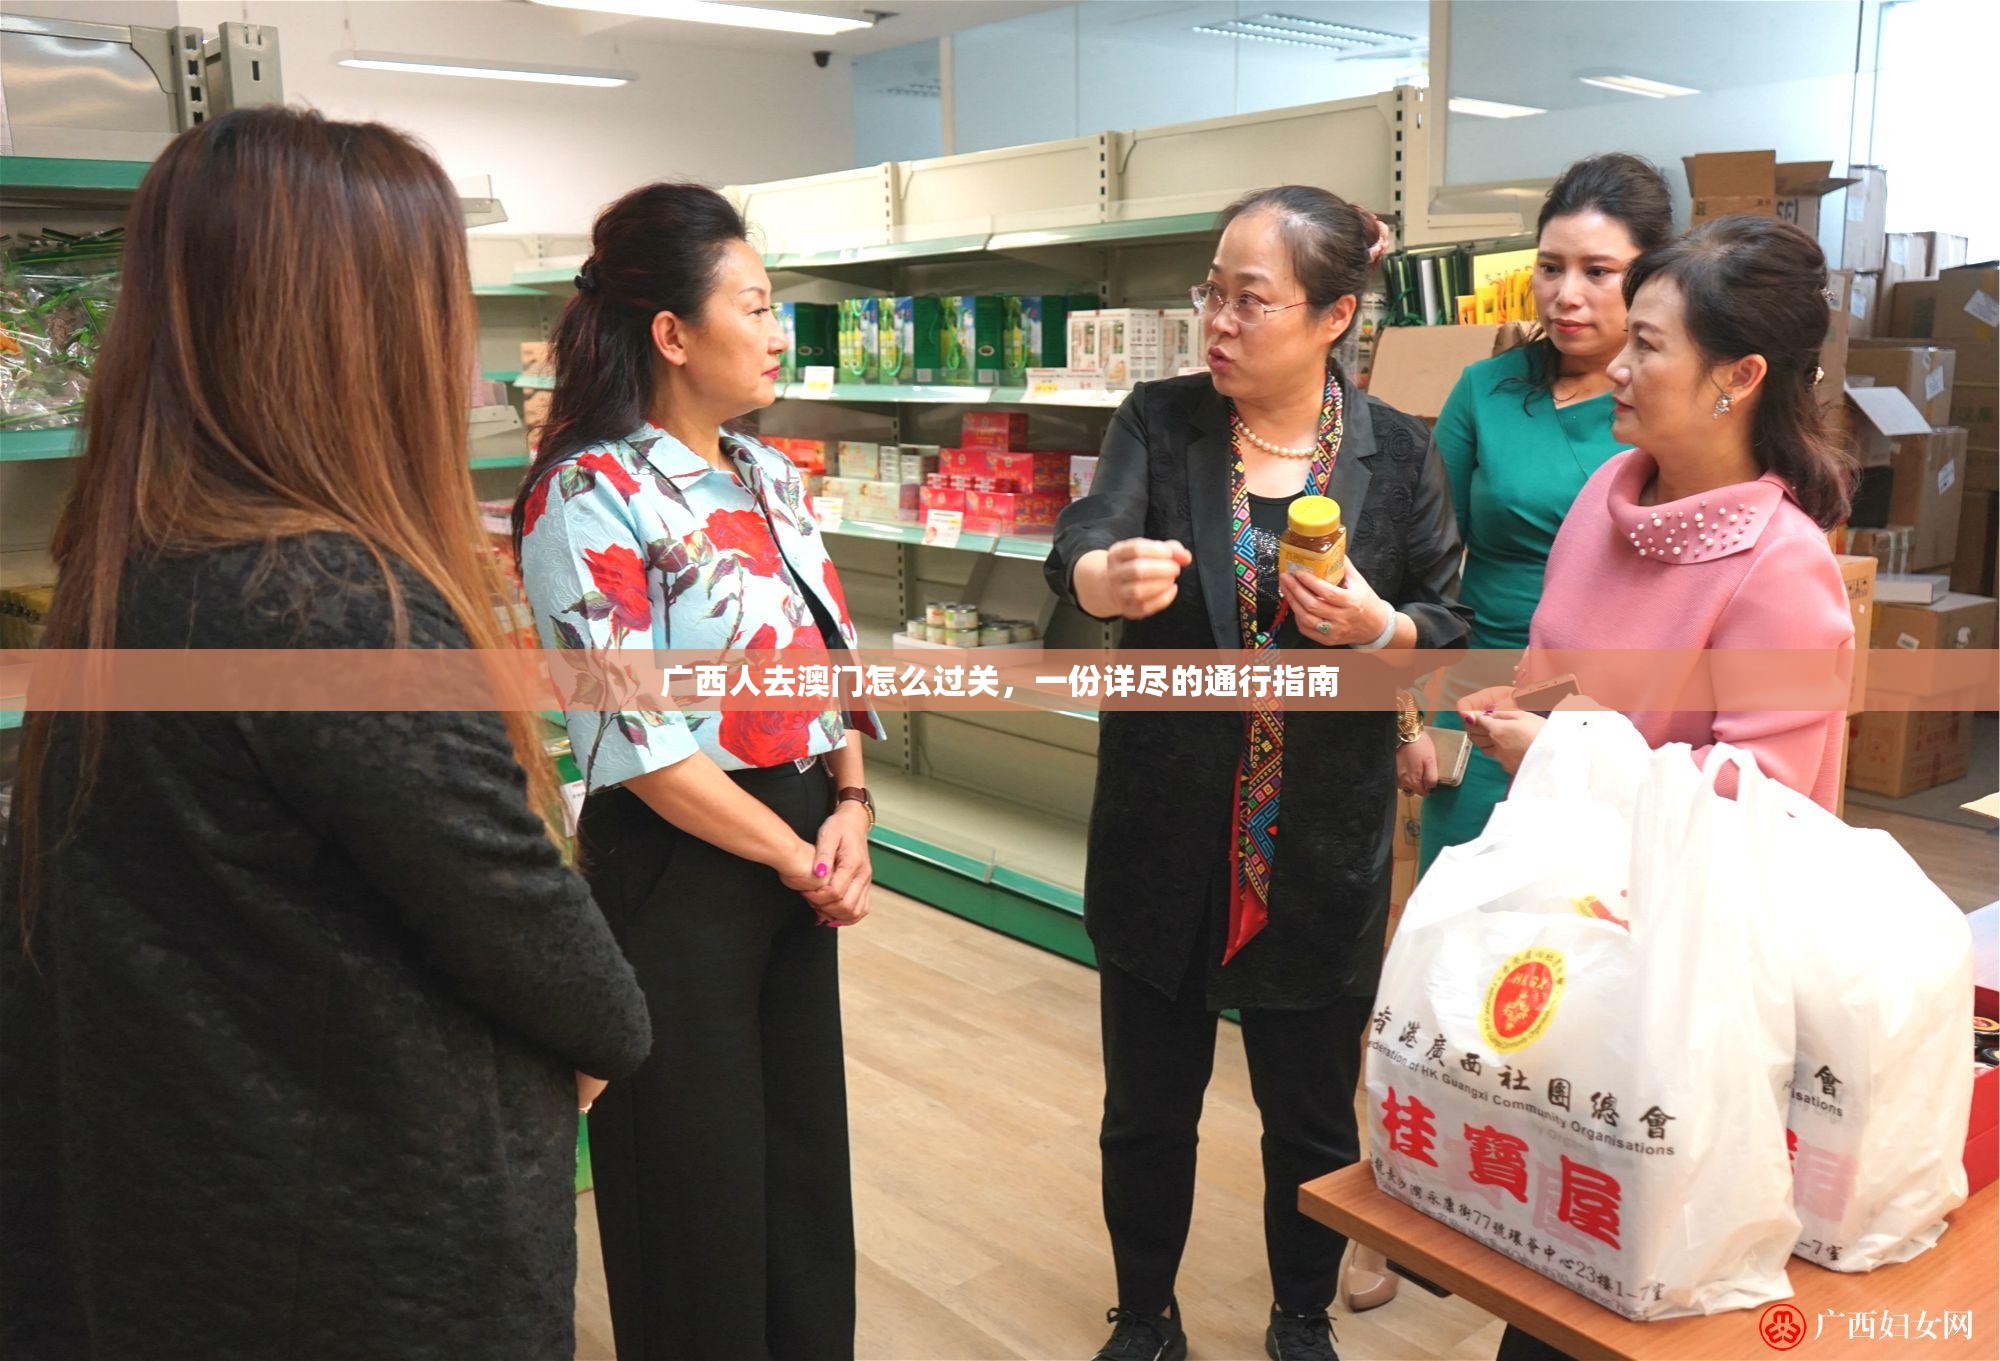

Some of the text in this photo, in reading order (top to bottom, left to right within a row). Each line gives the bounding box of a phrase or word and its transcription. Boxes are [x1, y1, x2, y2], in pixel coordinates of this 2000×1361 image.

[1382, 1086, 1622, 1250] 桂寶屋
[1408, 1061, 1420, 1073] of
[1421, 1064, 1439, 1081] HK
[1442, 1073, 1489, 1102] Guangxi
[1493, 1094, 1567, 1129] Community
[1570, 1120, 1676, 1156] Organisations
